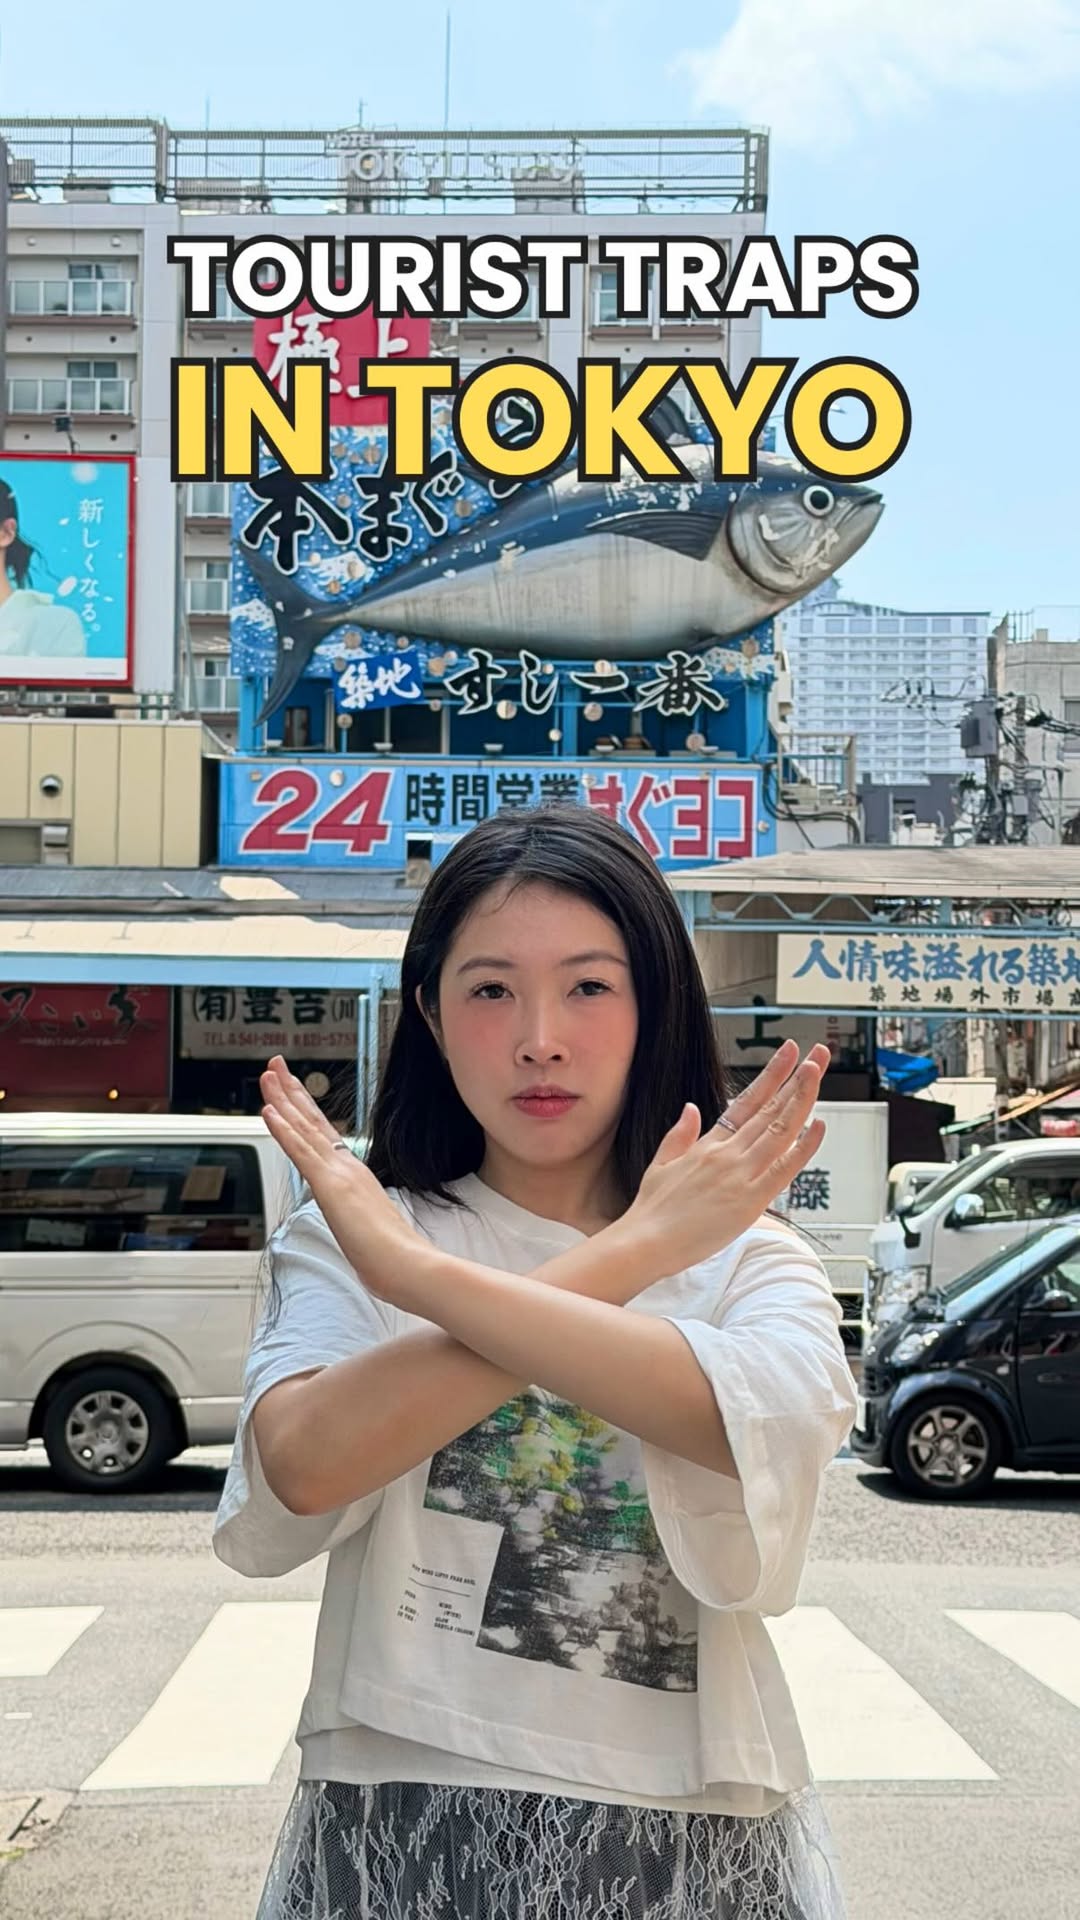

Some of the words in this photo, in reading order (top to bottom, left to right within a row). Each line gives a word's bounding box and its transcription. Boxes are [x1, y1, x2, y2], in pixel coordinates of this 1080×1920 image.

[79, 498, 103, 633] 新しくなる。
[338, 655, 421, 712] 築地
[443, 647, 725, 717] すし一番
